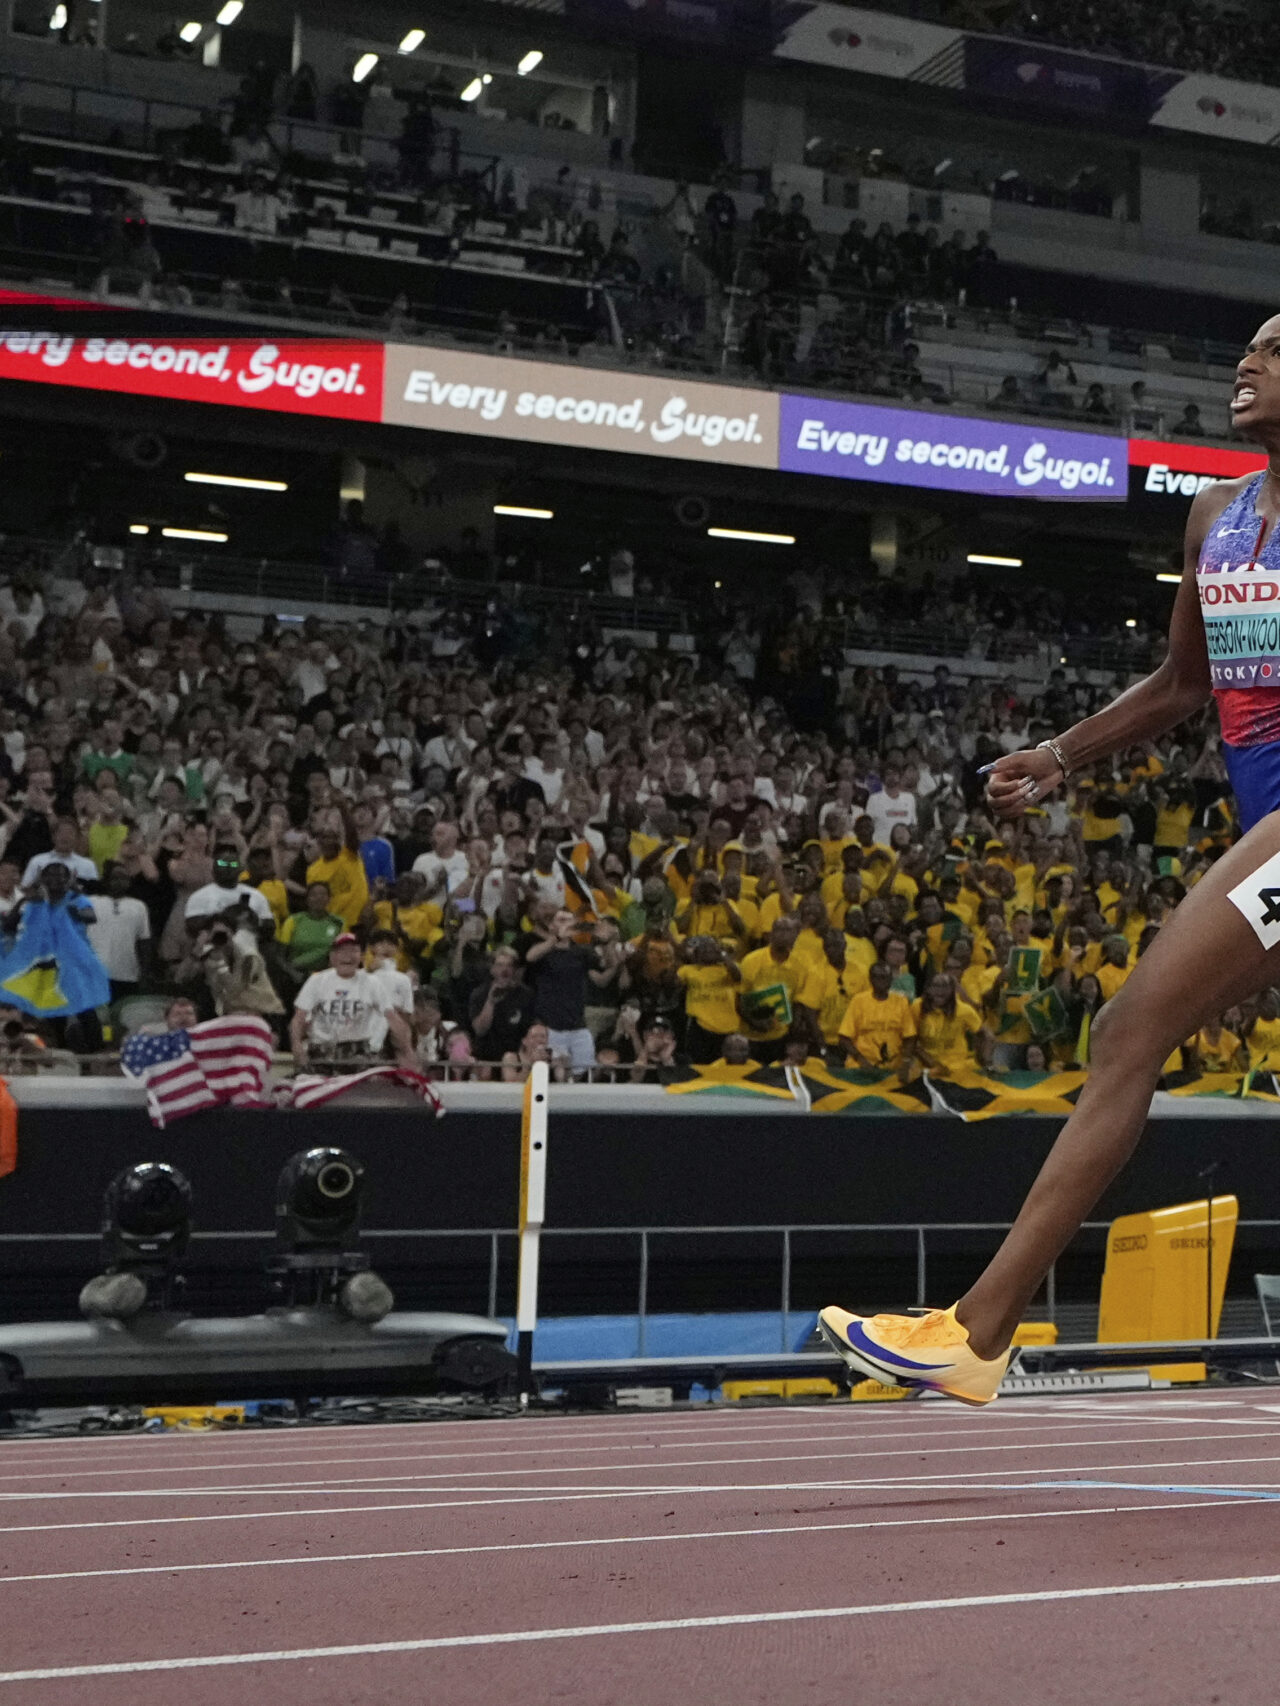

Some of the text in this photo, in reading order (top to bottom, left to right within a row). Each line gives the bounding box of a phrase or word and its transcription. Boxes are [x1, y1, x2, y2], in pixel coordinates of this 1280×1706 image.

[82, 338, 231, 382] second,
[237, 344, 365, 397] Sugoi.
[404, 370, 763, 446] Every second, Sugoi.
[797, 419, 1115, 489] Every second, Sugoi.
[1144, 463, 1217, 496] Ever
